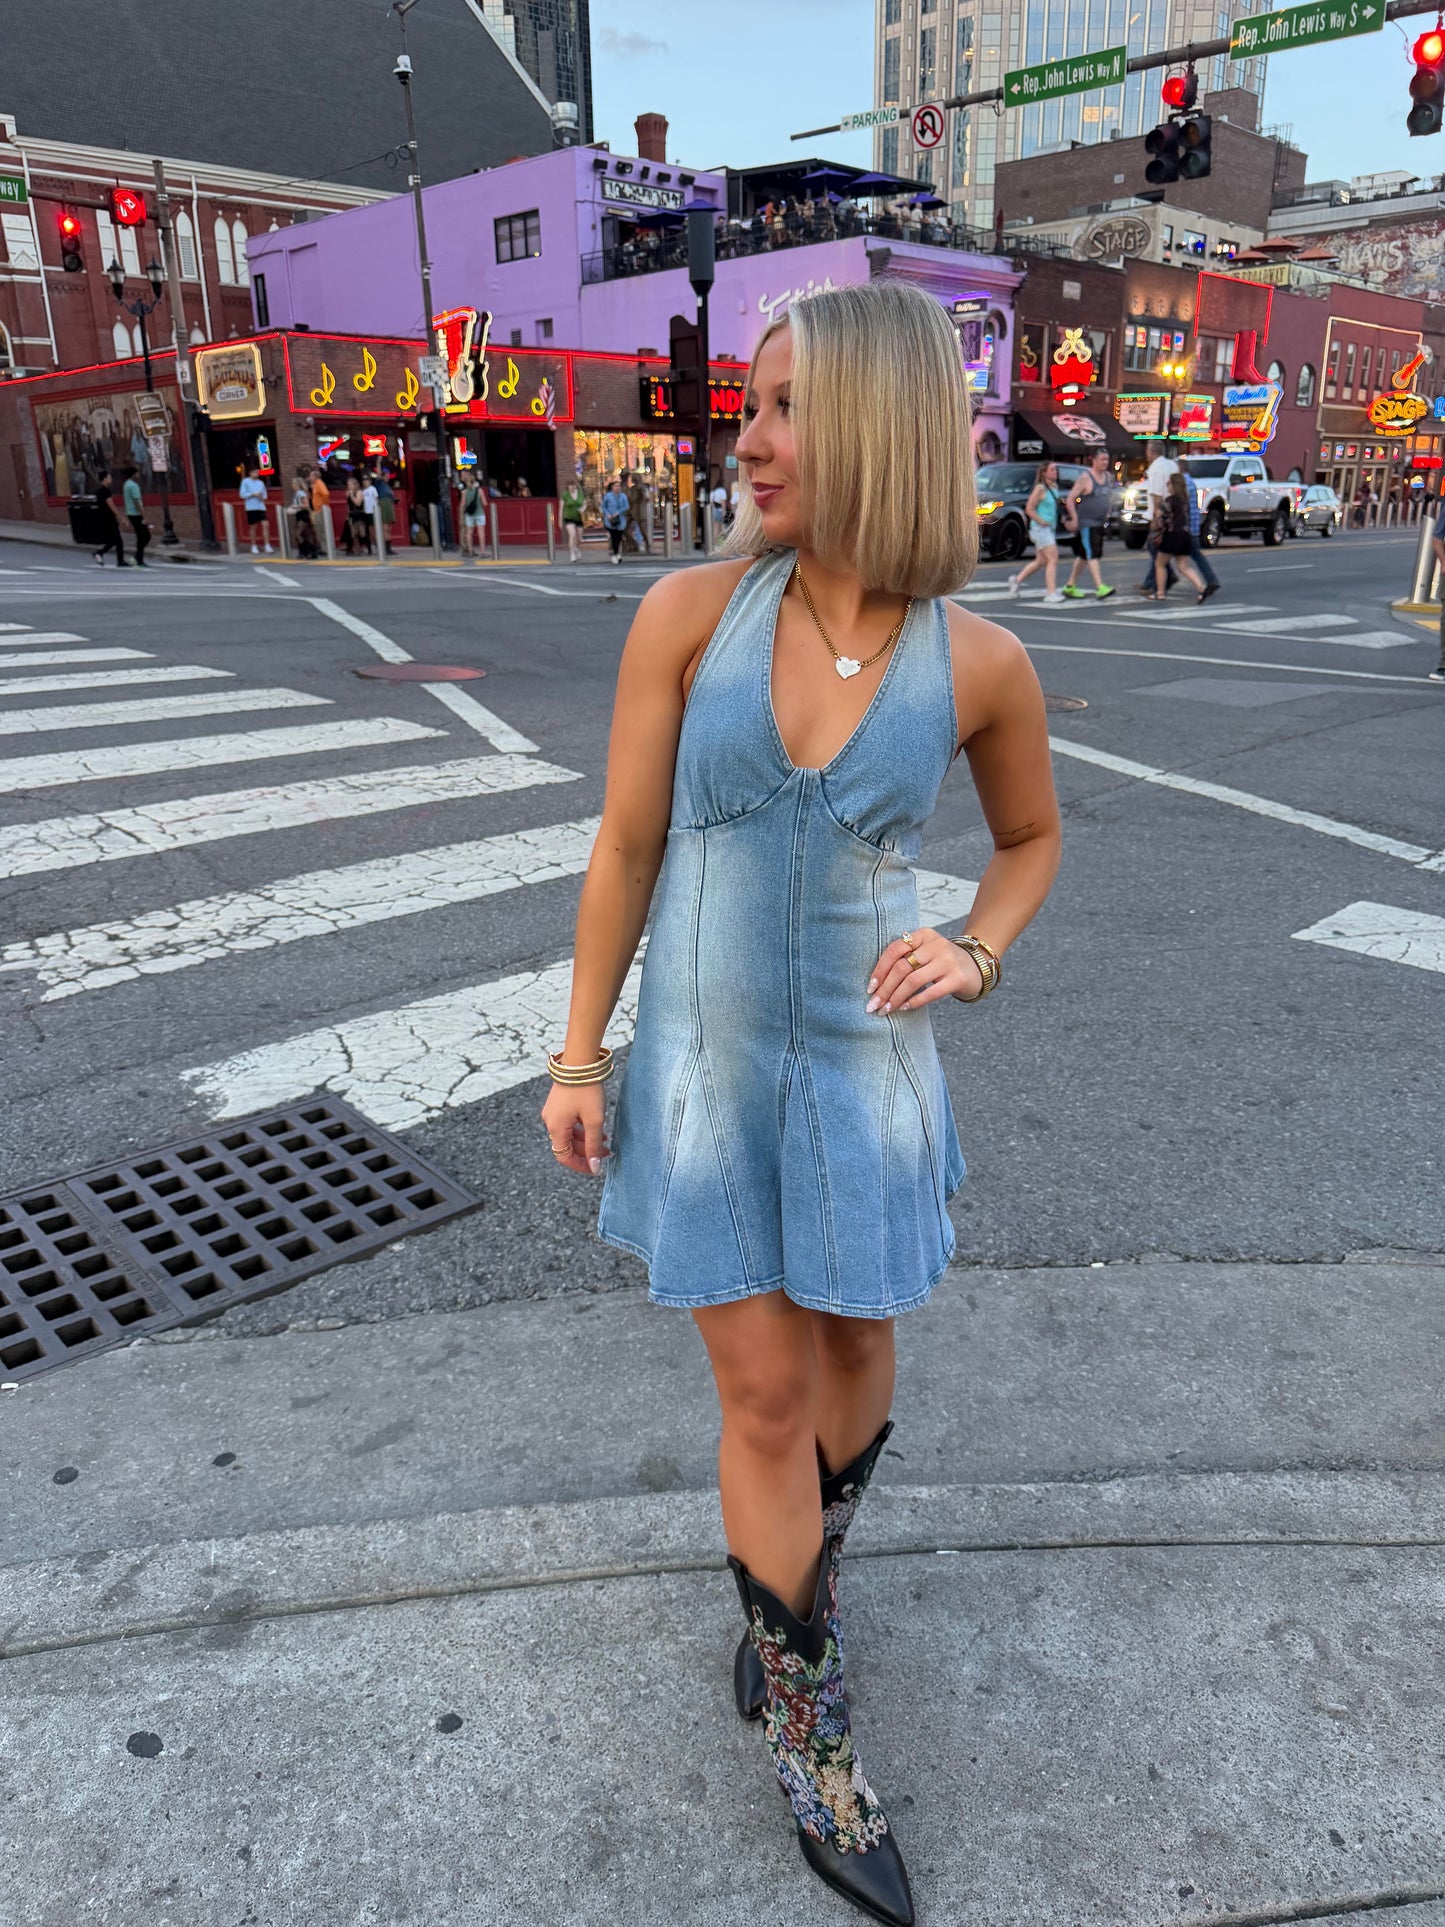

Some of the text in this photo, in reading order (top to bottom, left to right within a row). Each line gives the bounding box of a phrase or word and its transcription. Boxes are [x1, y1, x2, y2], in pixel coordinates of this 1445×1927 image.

[1239, 2, 1358, 51] Rep. John Lewis Way S
[1023, 55, 1121, 97] Rep. John Lewis Way N
[852, 107, 897, 128] PARKING
[1088, 227, 1147, 258] STAGE
[1371, 397, 1428, 423] STAGE
